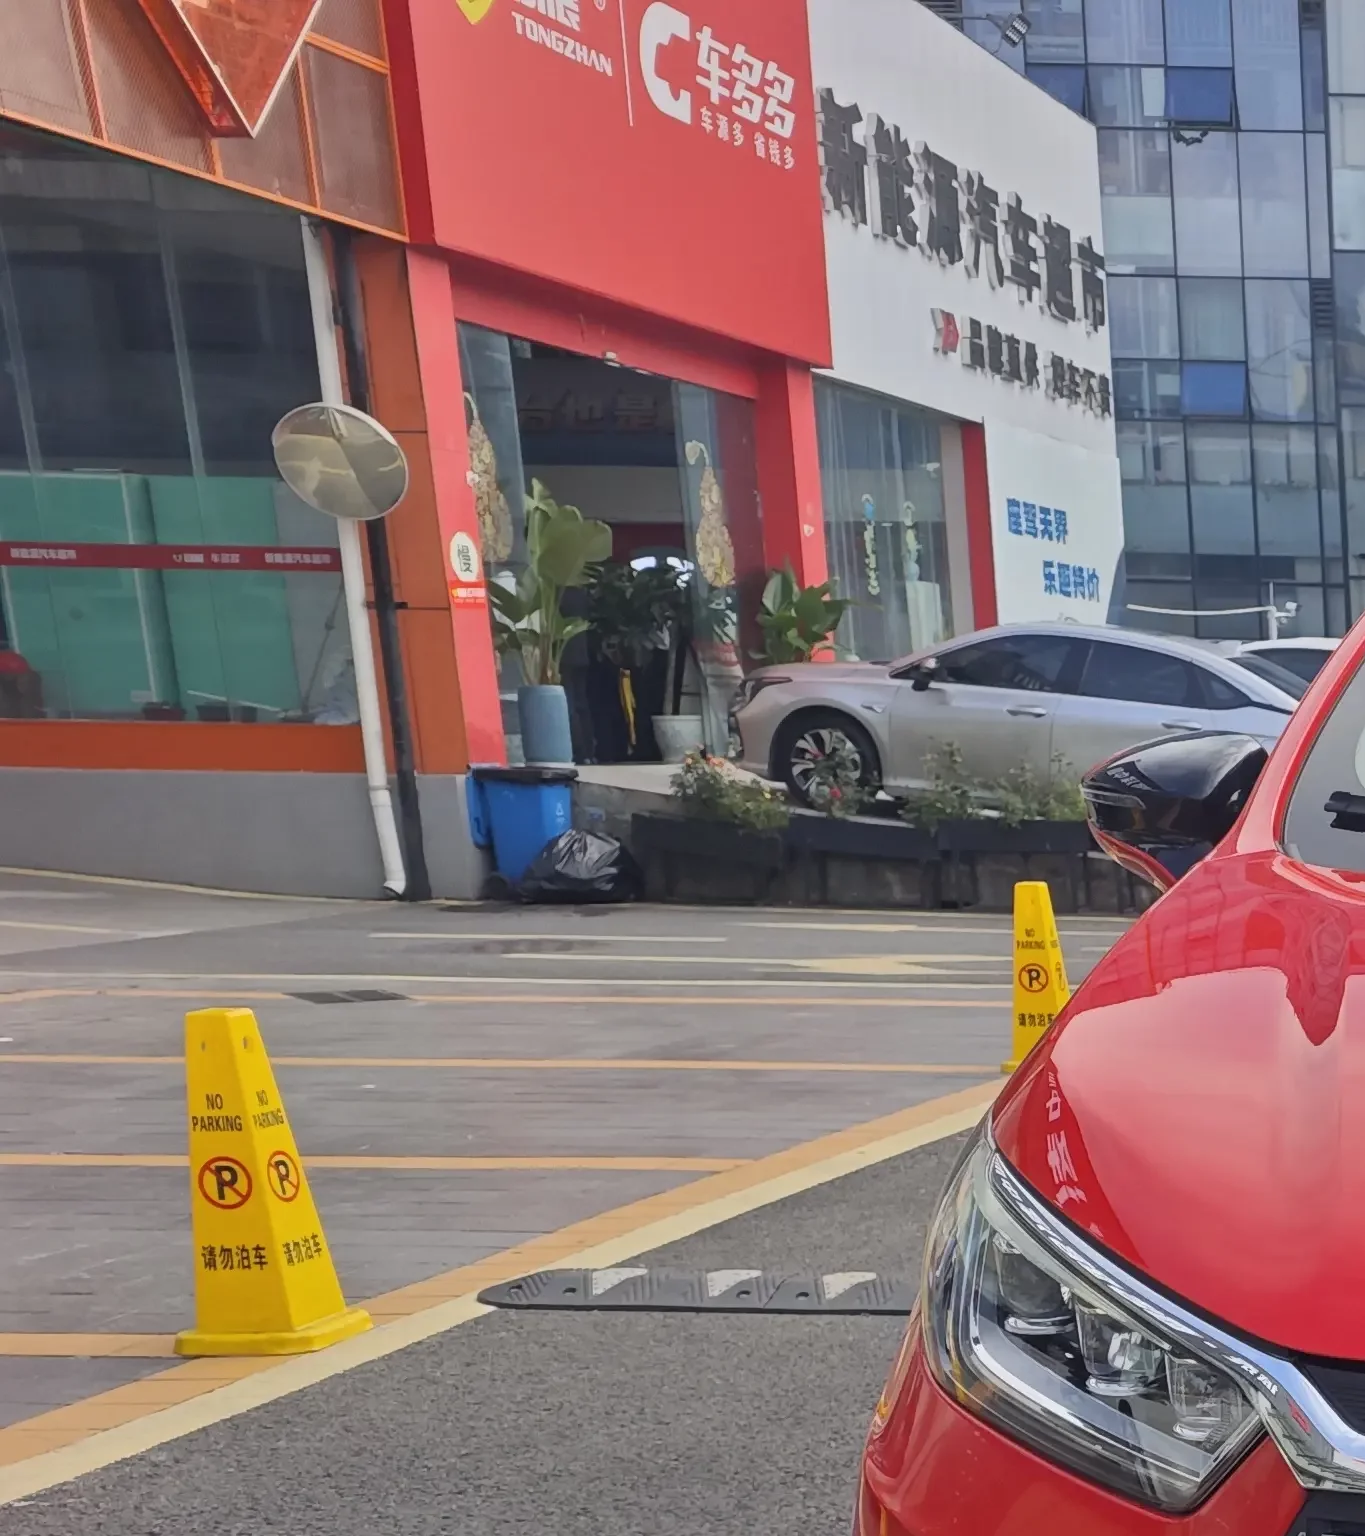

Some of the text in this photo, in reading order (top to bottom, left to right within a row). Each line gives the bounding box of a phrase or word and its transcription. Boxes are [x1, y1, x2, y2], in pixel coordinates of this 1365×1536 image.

[511, 11, 613, 77] TONGZHAN
[695, 25, 796, 139] 车多多
[700, 106, 796, 170] 车源多 省钱多
[457, 543, 473, 573] 慢
[205, 1093, 223, 1110] NO
[256, 1089, 269, 1107] NO
[192, 1115, 243, 1132] PARKING
[252, 1107, 284, 1130] PARKING
[201, 1244, 269, 1272] 请勿泊车
[283, 1231, 323, 1268] 请勿泊车
